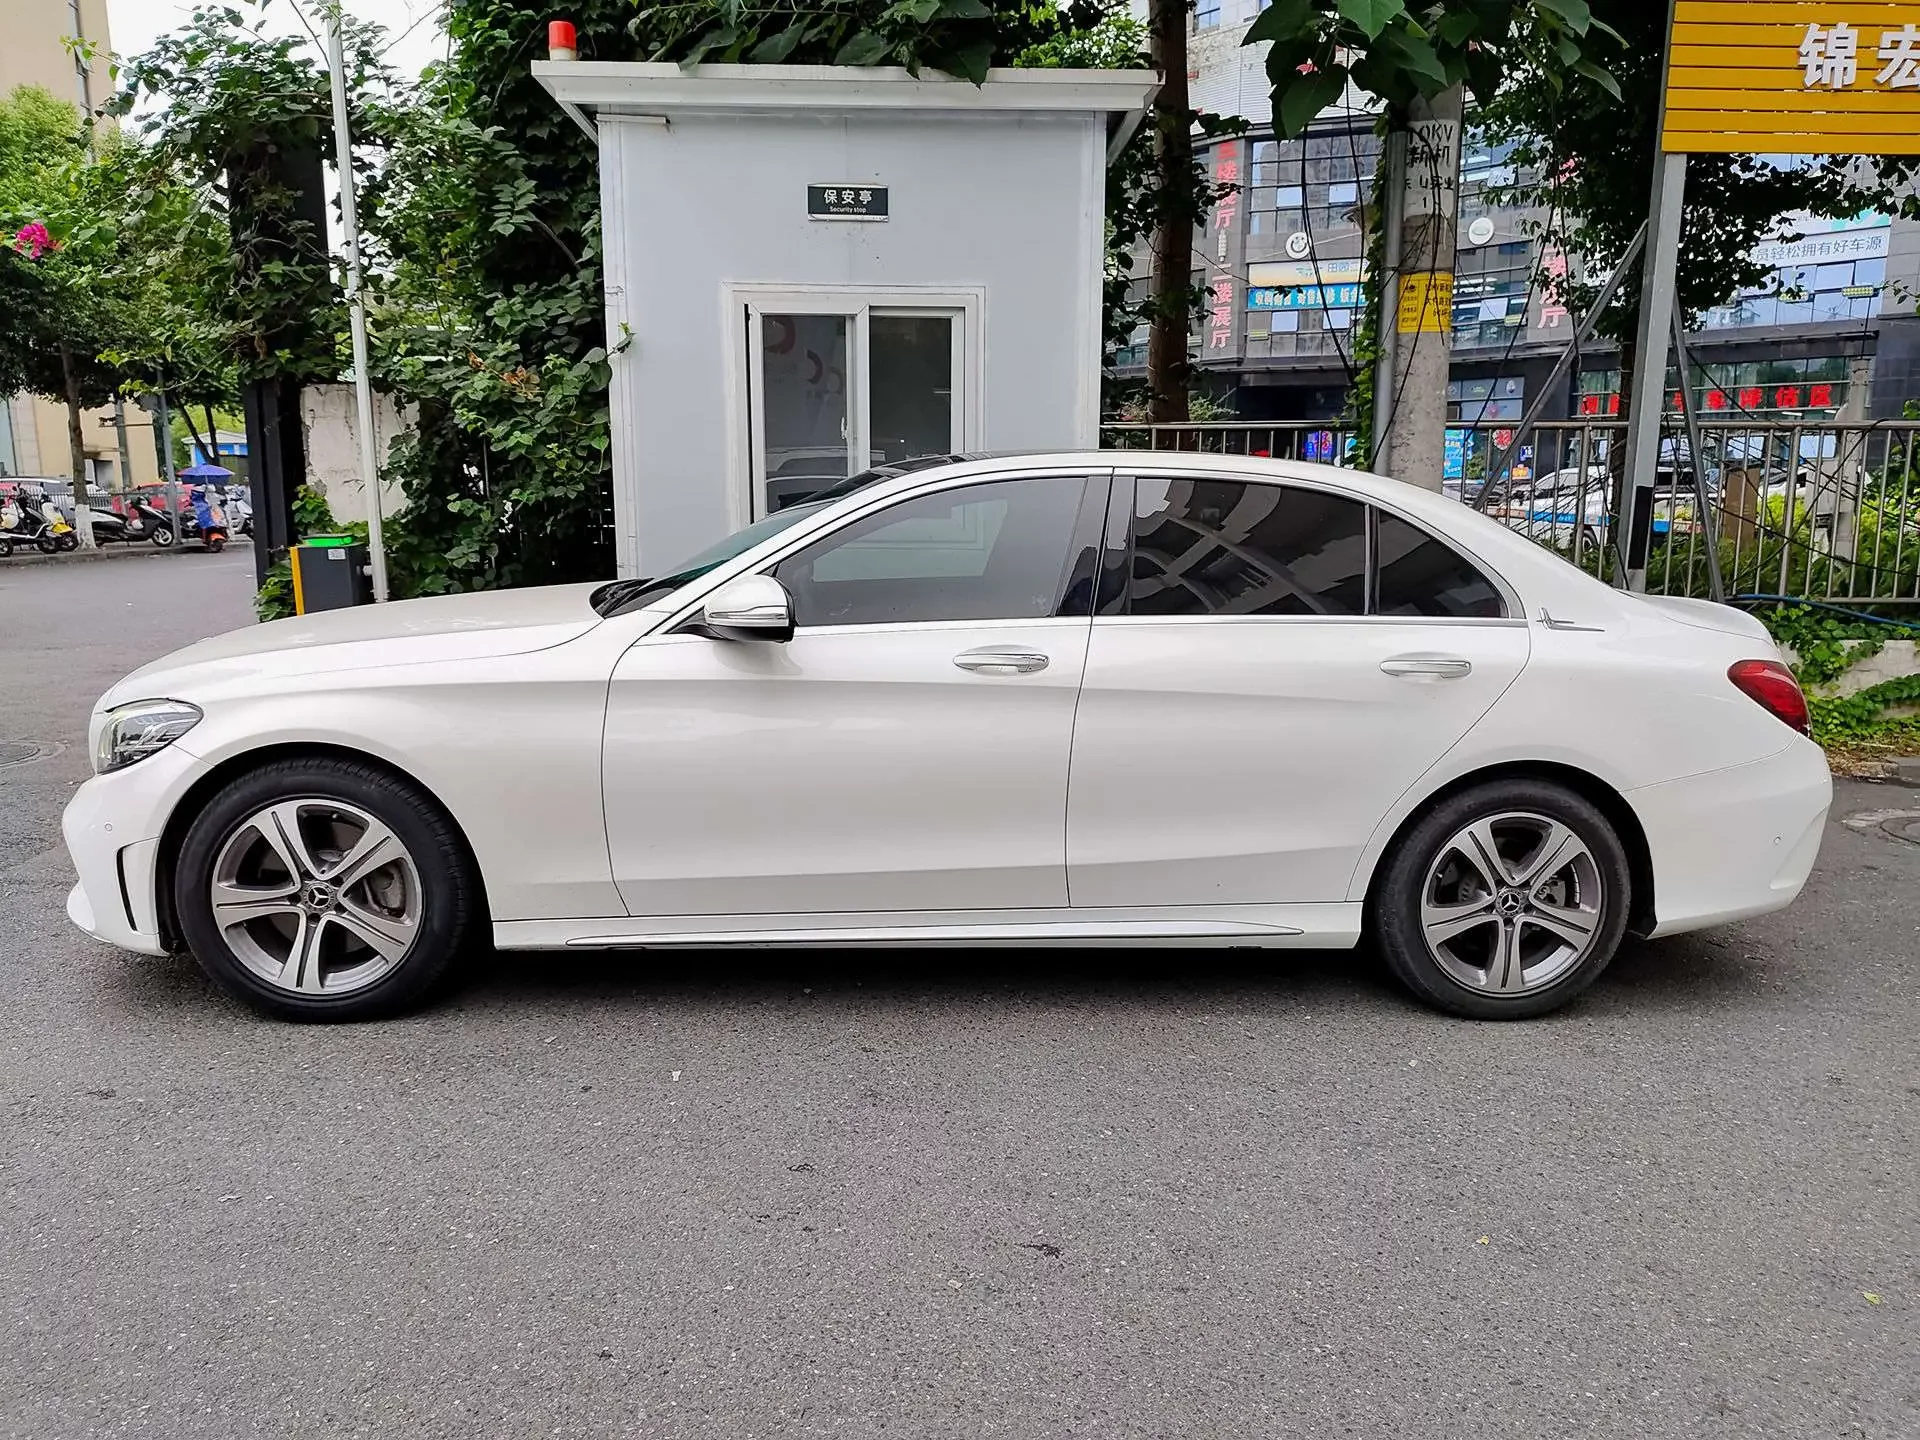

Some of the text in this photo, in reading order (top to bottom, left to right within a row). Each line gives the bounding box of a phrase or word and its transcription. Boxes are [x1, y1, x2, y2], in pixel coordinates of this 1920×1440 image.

[1797, 21, 1920, 90] 锦宏
[823, 188, 873, 205] 保安亭
[853, 206, 867, 214] stop
[1209, 262, 1233, 349] 二楼展厅
